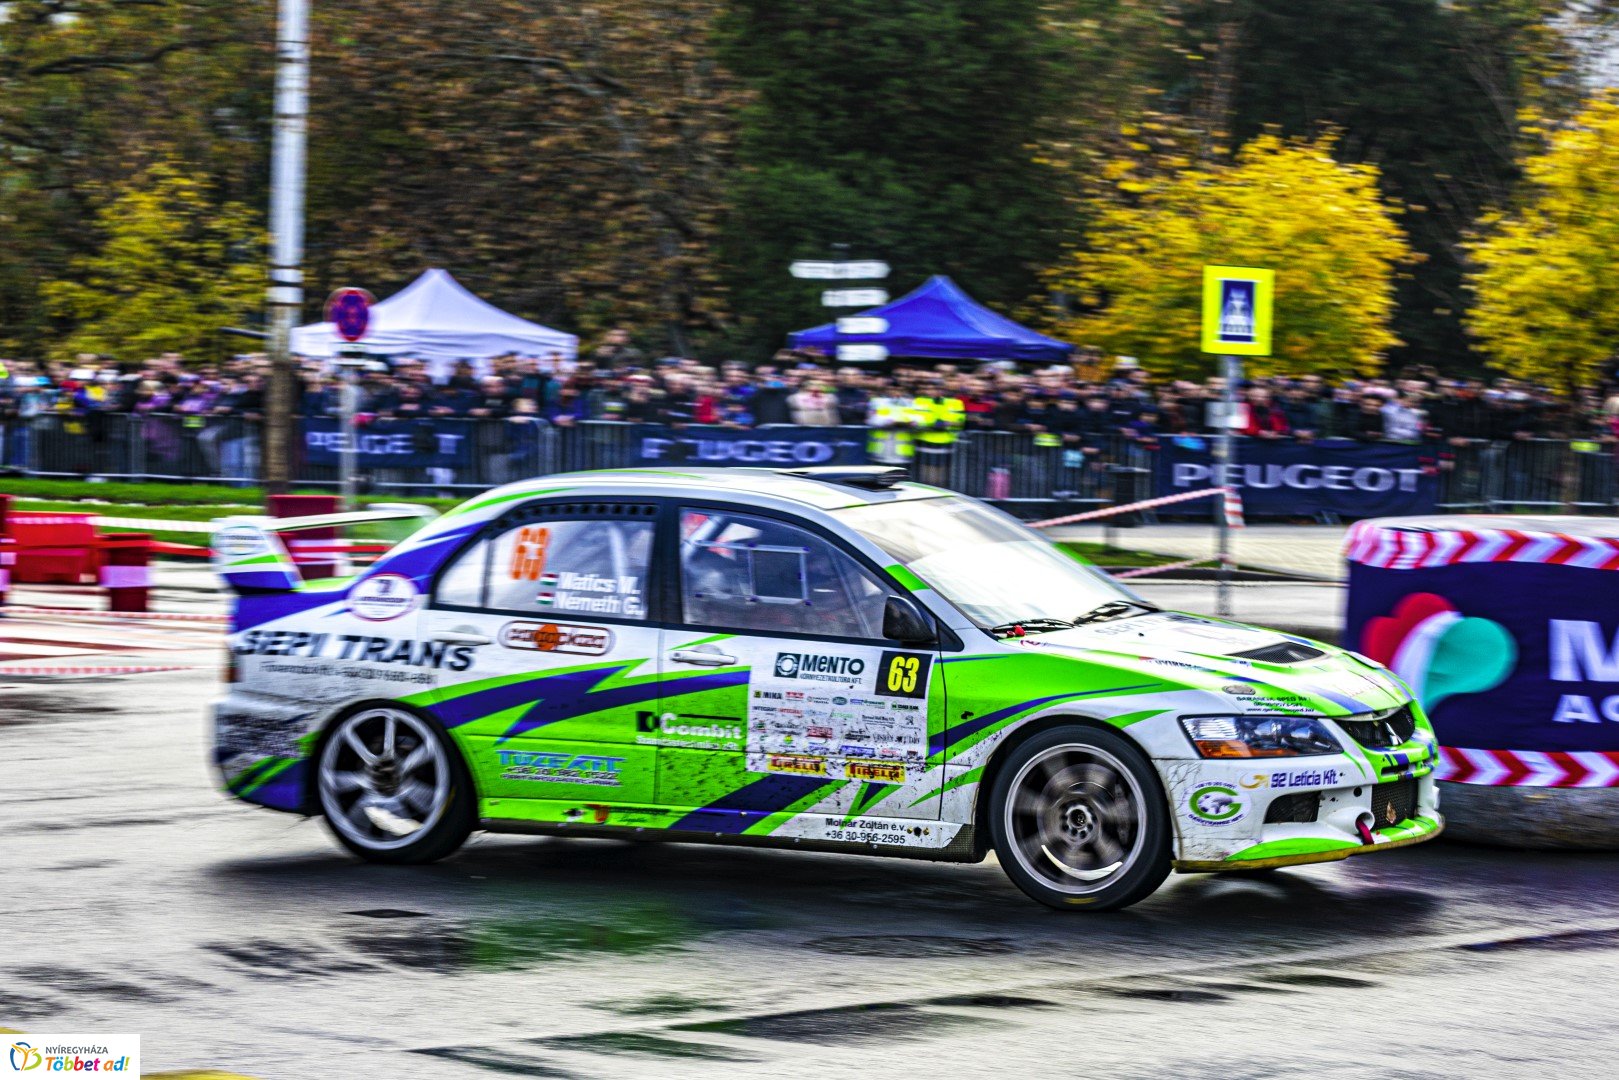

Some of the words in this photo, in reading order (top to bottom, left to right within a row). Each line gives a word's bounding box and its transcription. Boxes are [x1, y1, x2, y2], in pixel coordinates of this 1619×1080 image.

[1171, 462, 1423, 492] PEUGEOT
[237, 630, 326, 657] SEPI
[336, 634, 476, 672] TRANS
[887, 655, 920, 693] 63
[660, 712, 743, 739] Combit
[1271, 773, 1287, 788] 92
[825, 829, 843, 840] +36
